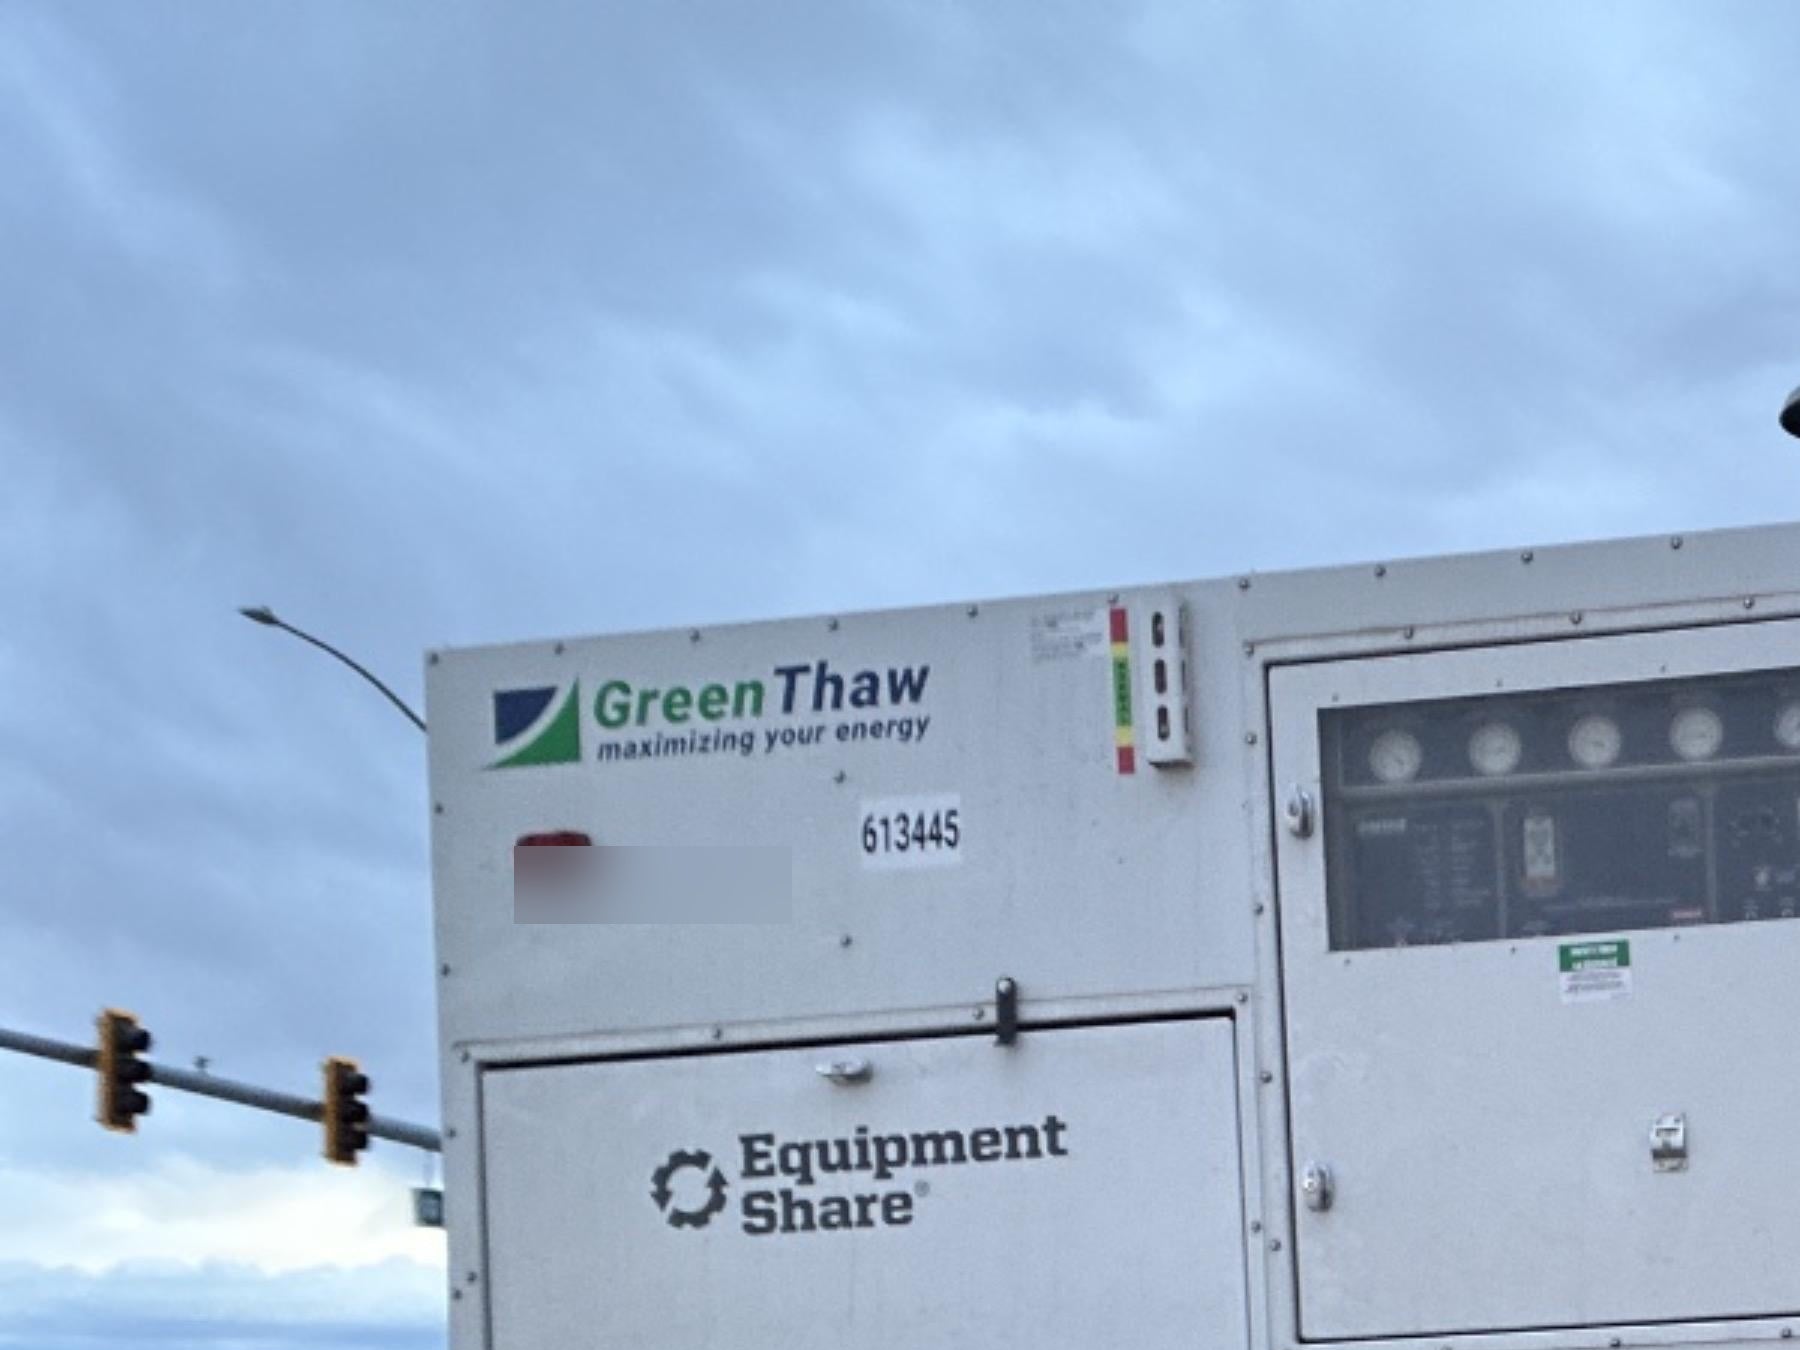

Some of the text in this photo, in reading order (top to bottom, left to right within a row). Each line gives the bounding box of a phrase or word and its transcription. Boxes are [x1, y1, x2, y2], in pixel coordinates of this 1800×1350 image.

[597, 715, 931, 761] maximizing your energy
[862, 808, 960, 854] 613445
[738, 1114, 1068, 1185] Equipment
